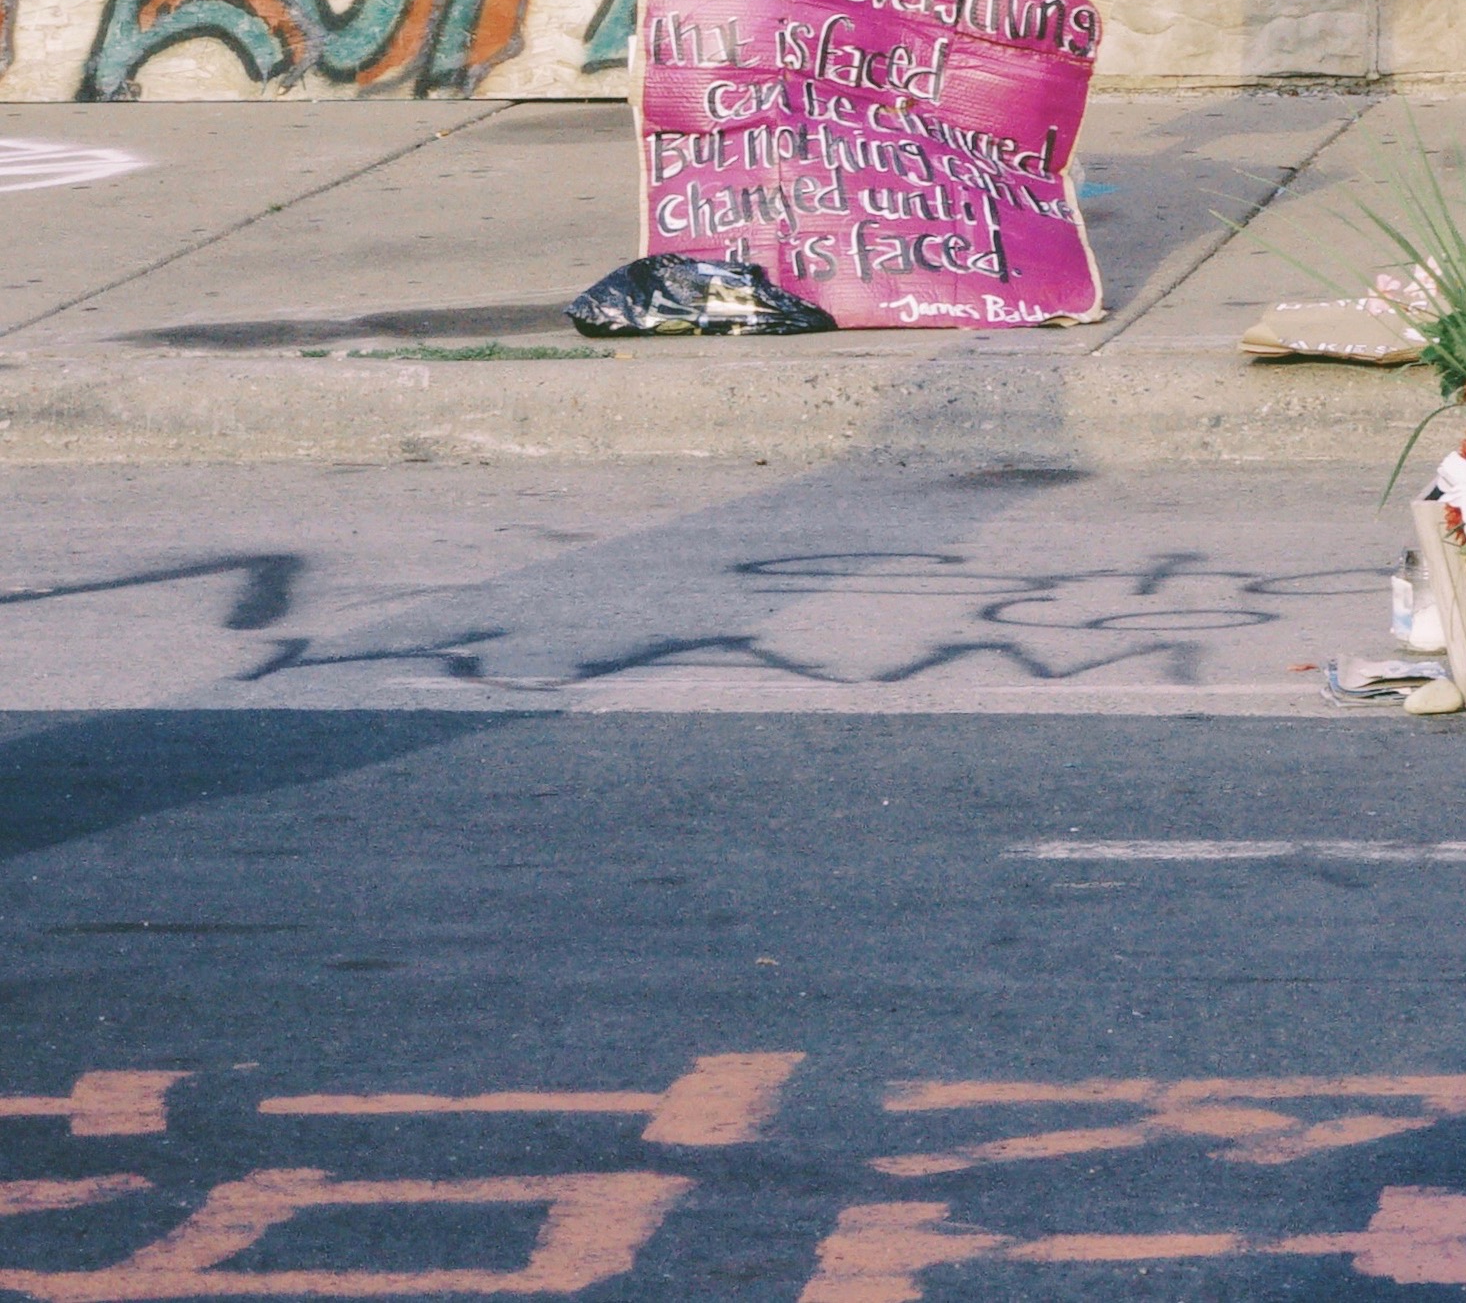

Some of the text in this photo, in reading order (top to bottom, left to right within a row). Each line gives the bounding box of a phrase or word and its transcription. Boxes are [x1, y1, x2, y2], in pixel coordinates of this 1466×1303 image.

[648, 9, 950, 106] that is faced
[702, 78, 1059, 183] can be changed
[742, 122, 936, 187] nothing
[655, 173, 1000, 239] changed until
[789, 230, 838, 282] is
